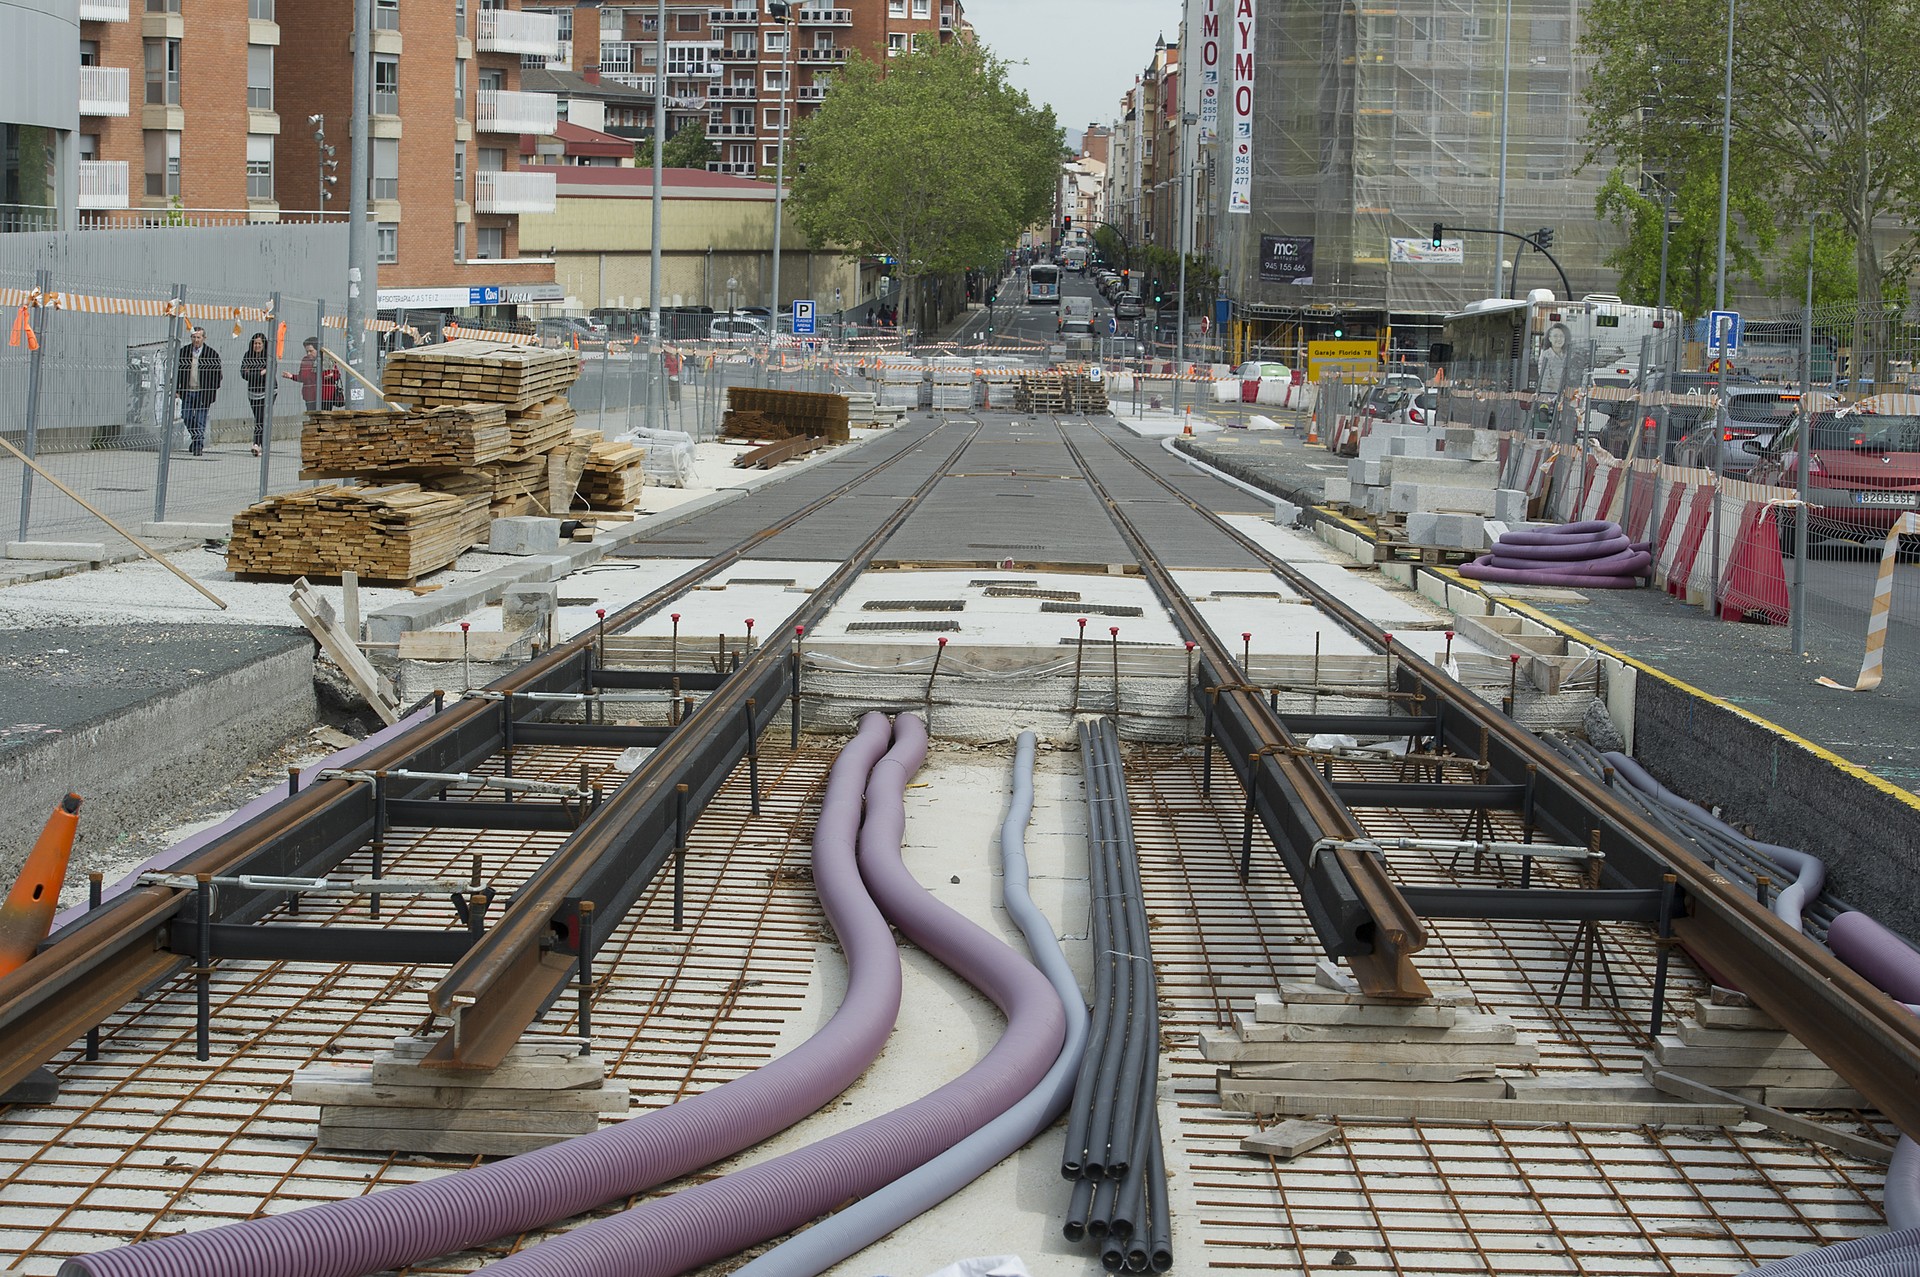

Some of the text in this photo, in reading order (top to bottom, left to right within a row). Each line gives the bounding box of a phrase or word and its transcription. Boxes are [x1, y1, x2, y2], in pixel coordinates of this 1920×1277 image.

[1235, 0, 1253, 116] AYMO
[1235, 156, 1249, 164] 945
[1234, 177, 1249, 185] 477
[1264, 261, 1278, 270] 945
[411, 294, 439, 302] GASTEIZ
[799, 304, 810, 317] P
[1862, 492, 1913, 504] 8209 CSF
